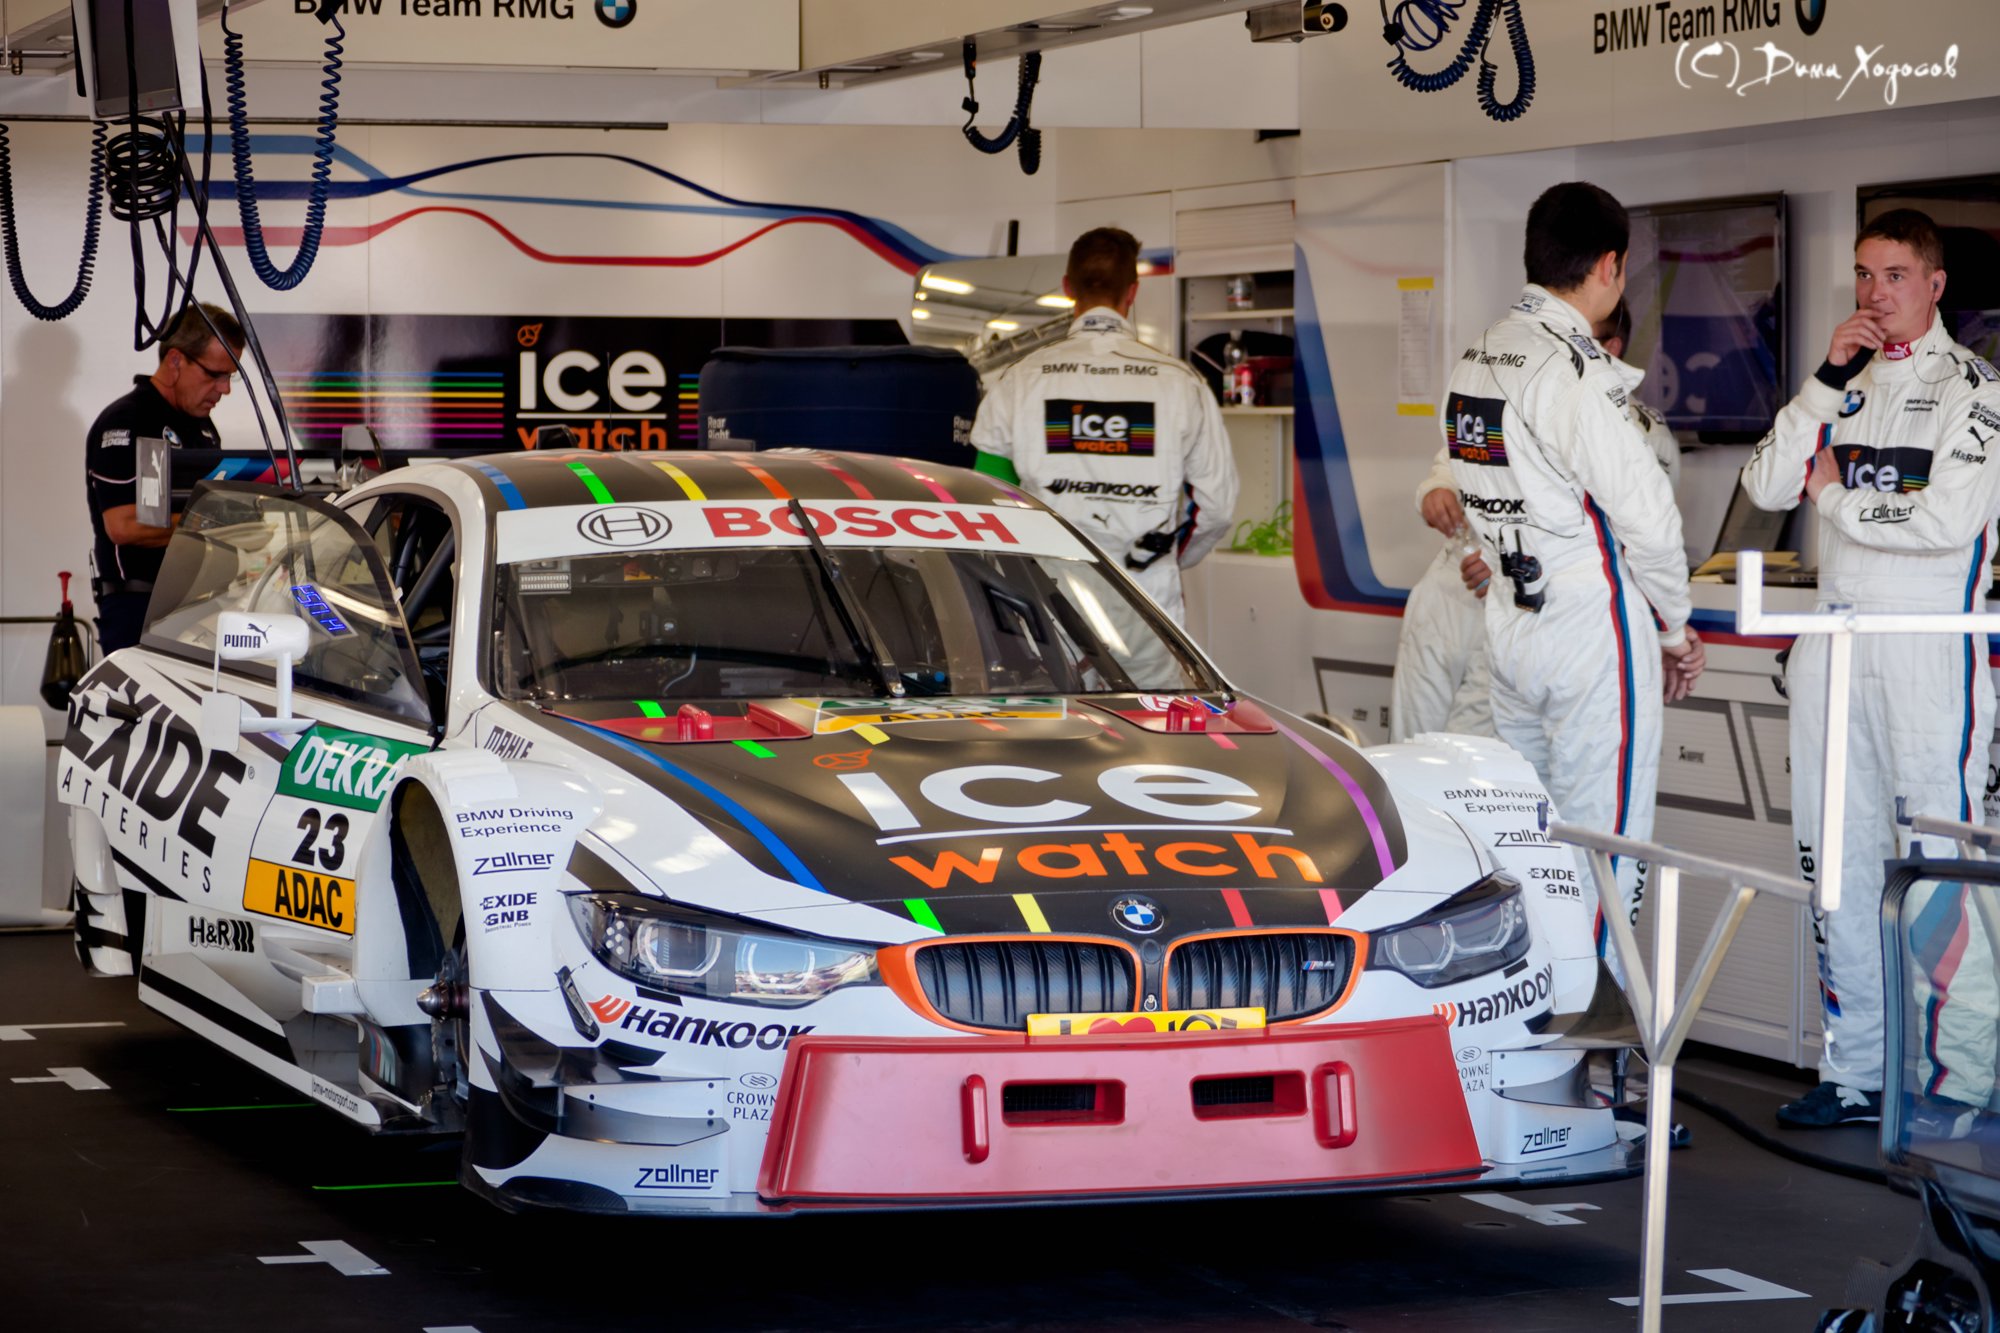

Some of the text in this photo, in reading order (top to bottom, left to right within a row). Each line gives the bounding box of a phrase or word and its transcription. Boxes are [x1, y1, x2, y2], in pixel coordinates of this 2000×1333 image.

[1594, 0, 1780, 53] BMW Team RMG
[1042, 363, 1159, 376] BMW Team RMG
[1497, 353, 1526, 368] RMG
[519, 350, 667, 411] ice
[1072, 413, 1129, 438] ice
[1457, 413, 1485, 443] ice
[1968, 410, 2000, 432] EDGE
[1073, 440, 1129, 453] watch
[1846, 460, 1900, 492] ice
[701, 506, 1020, 545] BOSCH
[224, 633, 262, 649] PUMA
[294, 735, 410, 800] DEKRA
[836, 764, 1263, 831] ice
[1443, 788, 1549, 803] BMW Driving
[456, 807, 574, 823] BMW Driving
[291, 807, 350, 871] 23
[460, 822, 562, 838] Experience
[888, 833, 1324, 889] watch
[1528, 867, 1576, 882] EXIDE
[274, 868, 343, 928] ADAC
[1544, 883, 1580, 897] GNB
[479, 892, 537, 911] EXIDE
[483, 909, 529, 927] GNB
[1460, 1063, 1490, 1080] OWNE
[727, 1091, 777, 1106] CROWN
[733, 1107, 774, 1121] PLAZ
